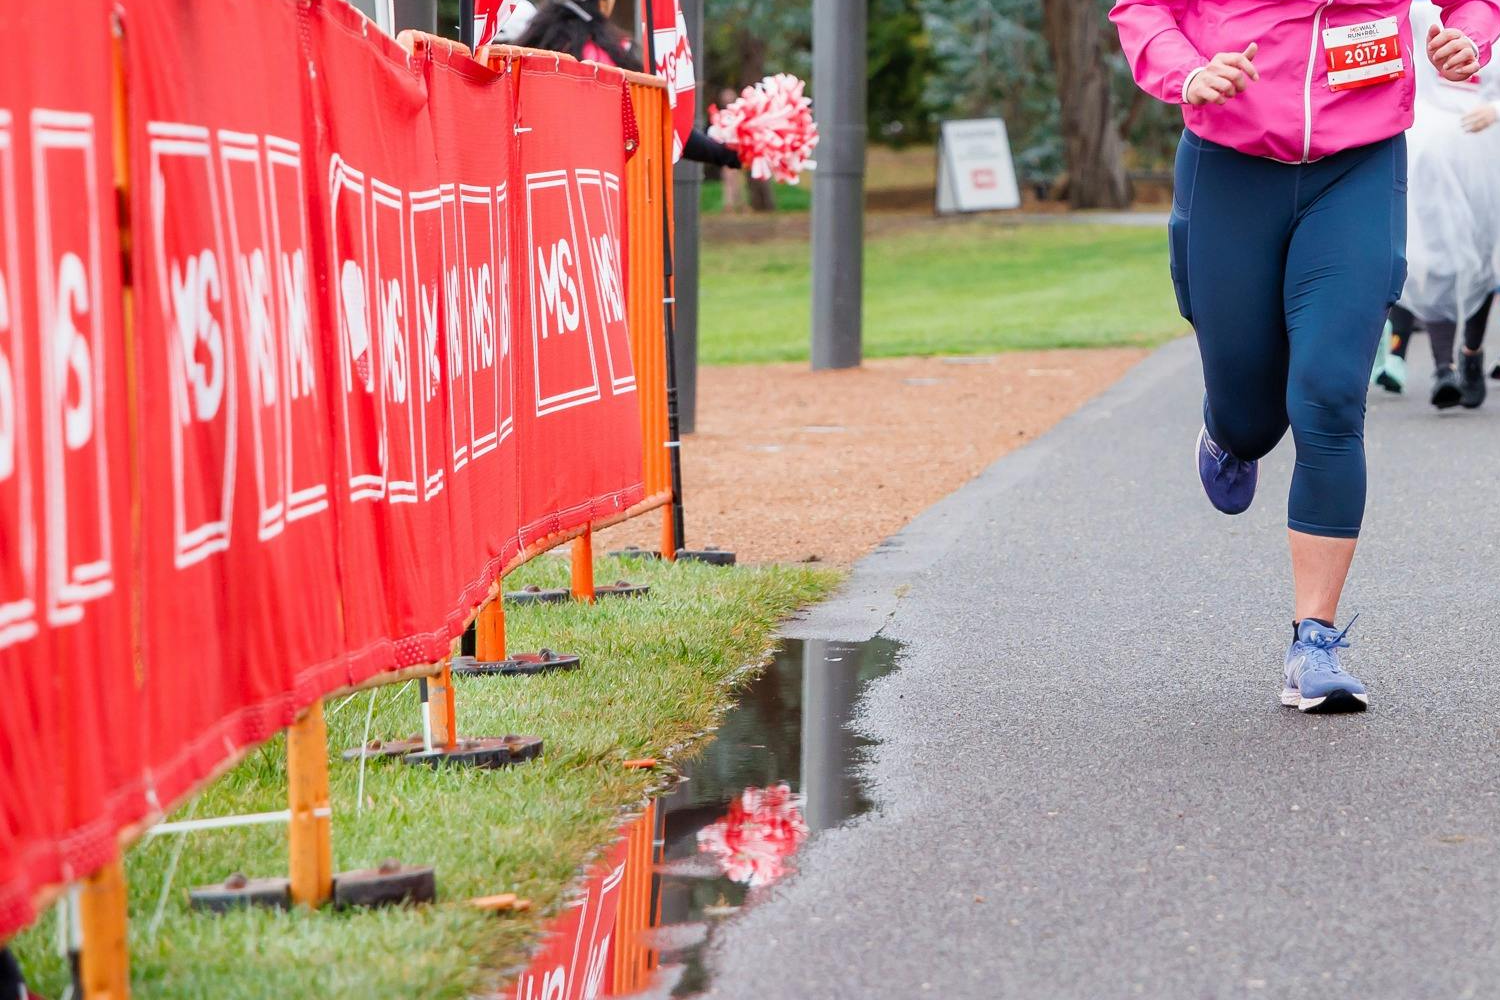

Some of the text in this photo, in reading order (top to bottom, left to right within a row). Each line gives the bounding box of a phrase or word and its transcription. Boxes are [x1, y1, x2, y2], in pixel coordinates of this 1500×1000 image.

[1344, 43, 1388, 64] 20173
[469, 262, 494, 373] MS
[537, 237, 581, 339] MS
[592, 232, 624, 325] MS
